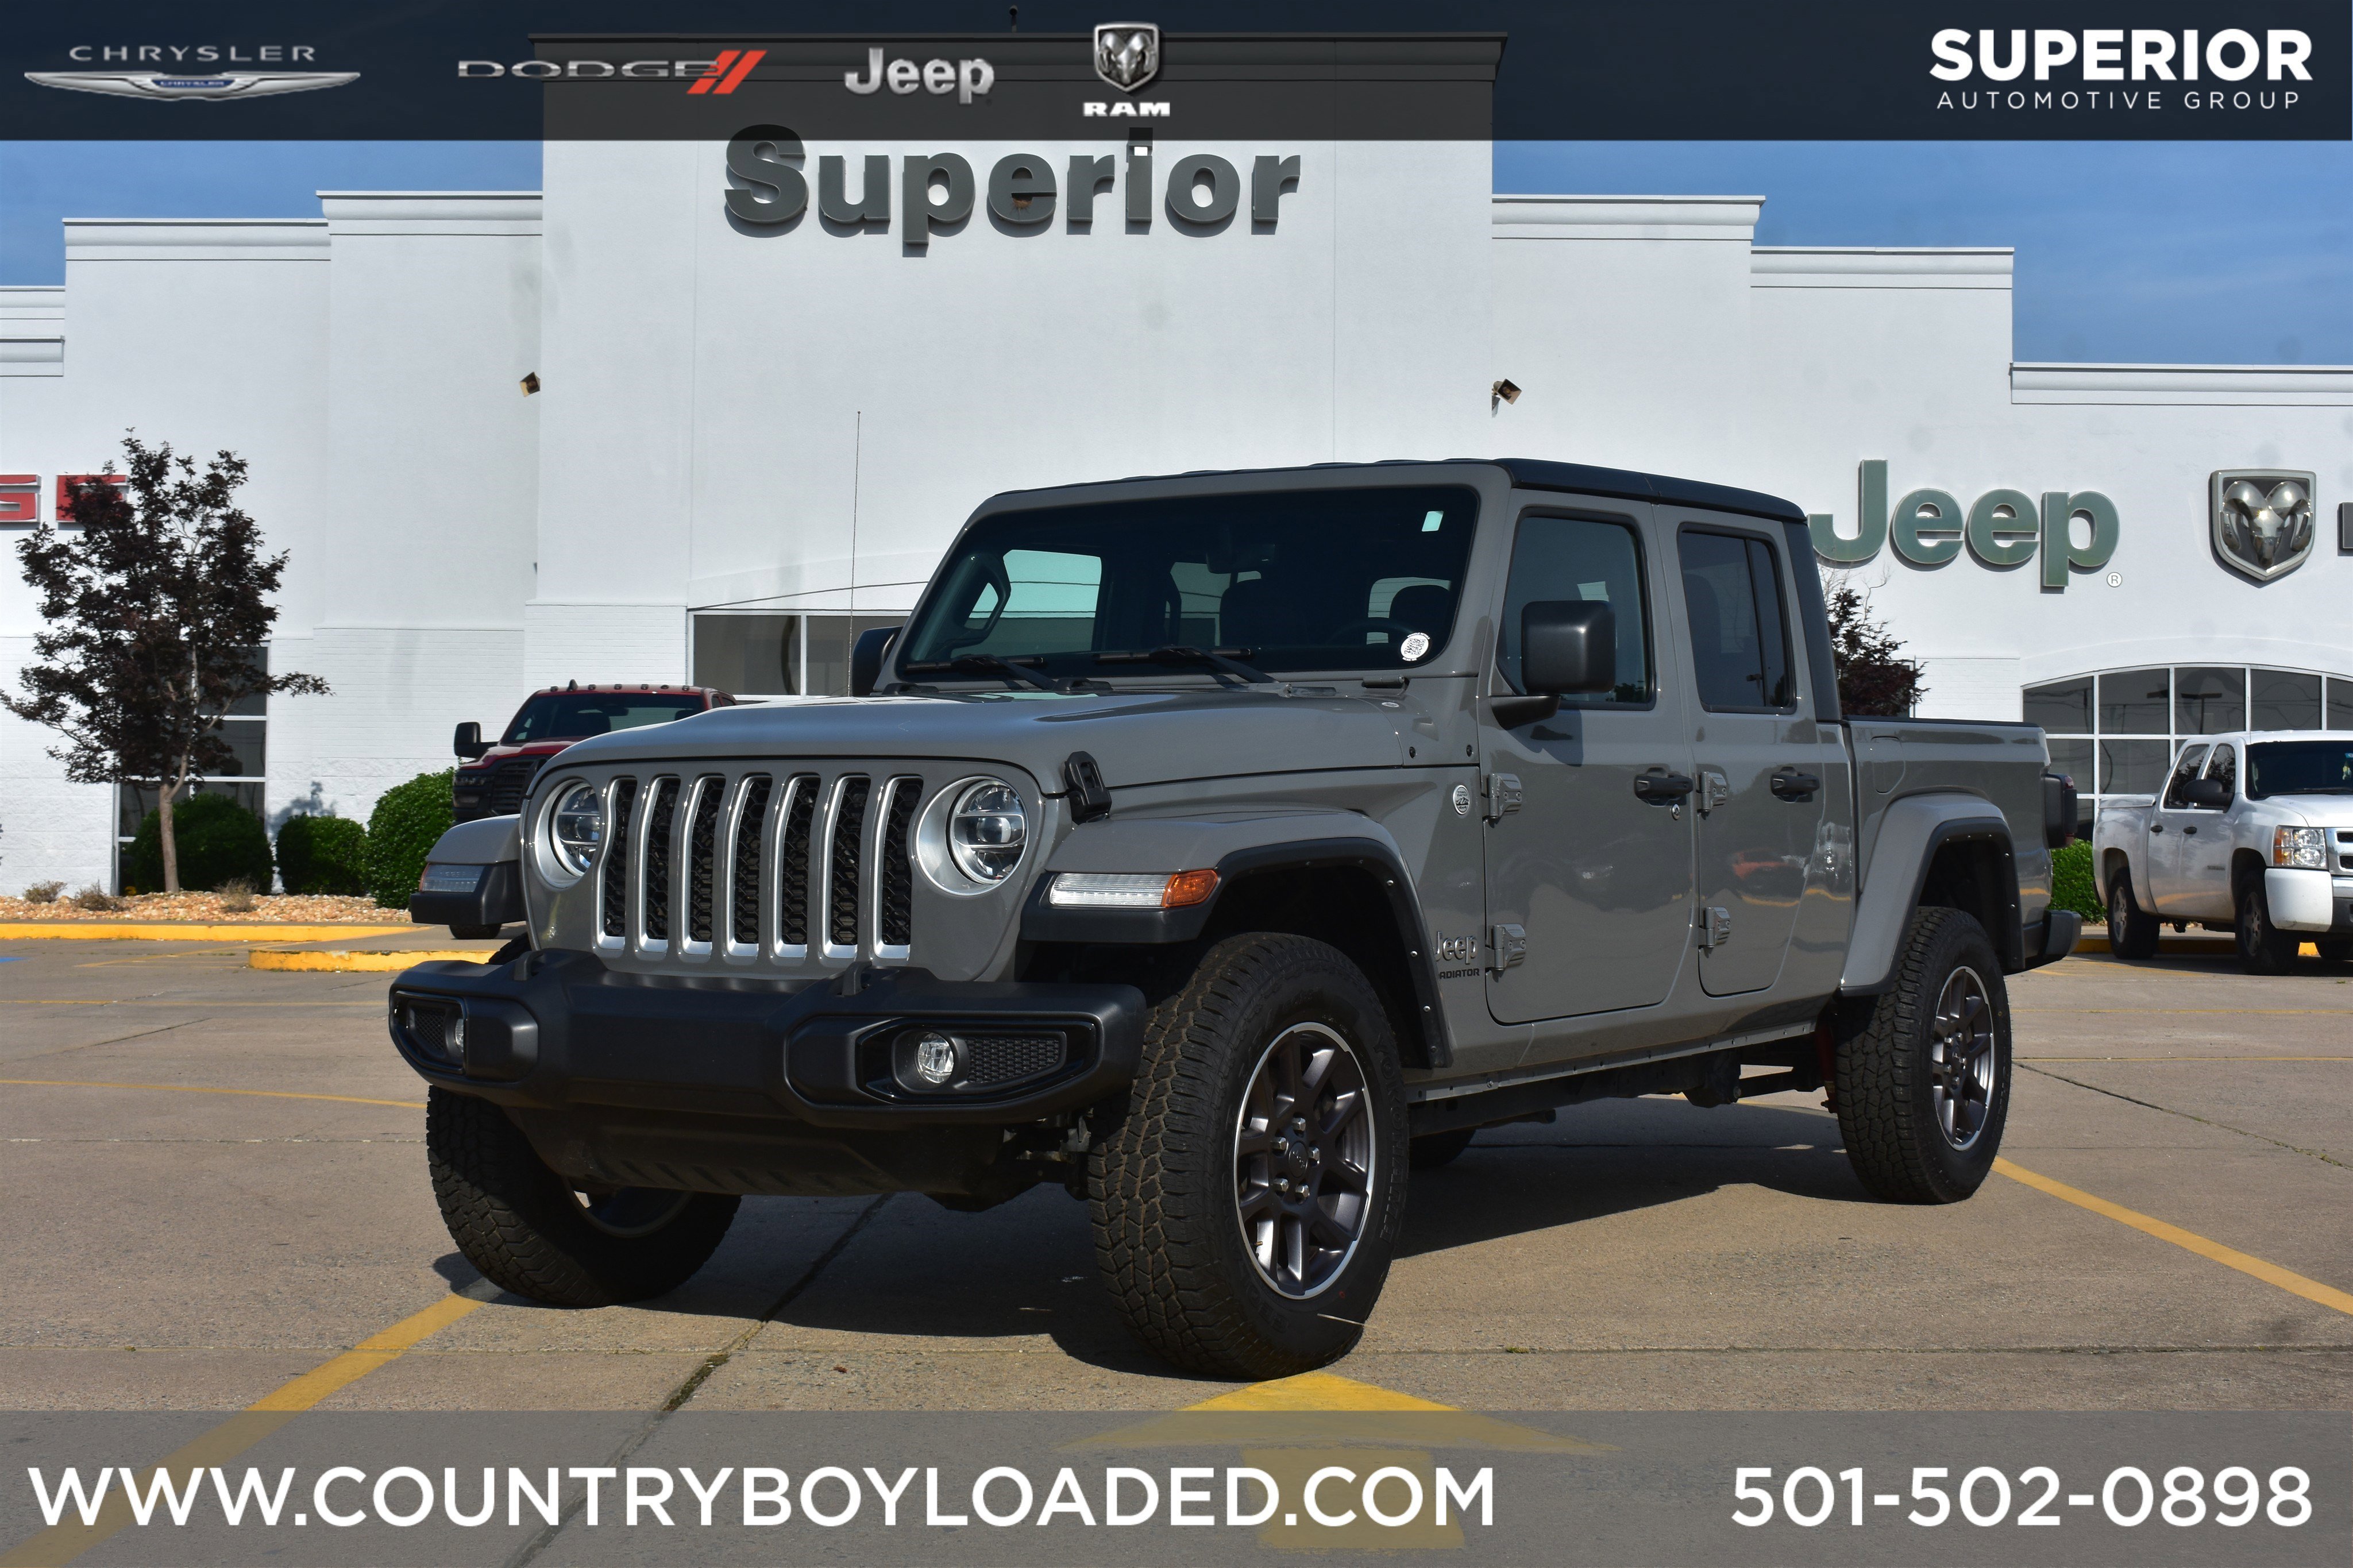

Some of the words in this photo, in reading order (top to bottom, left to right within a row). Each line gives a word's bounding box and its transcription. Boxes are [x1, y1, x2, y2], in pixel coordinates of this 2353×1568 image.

[724, 124, 1301, 247] Superior
[1806, 459, 2120, 588] Jeep
[1434, 930, 1478, 965] Jeep
[1439, 968, 1480, 979] ADIATOR
